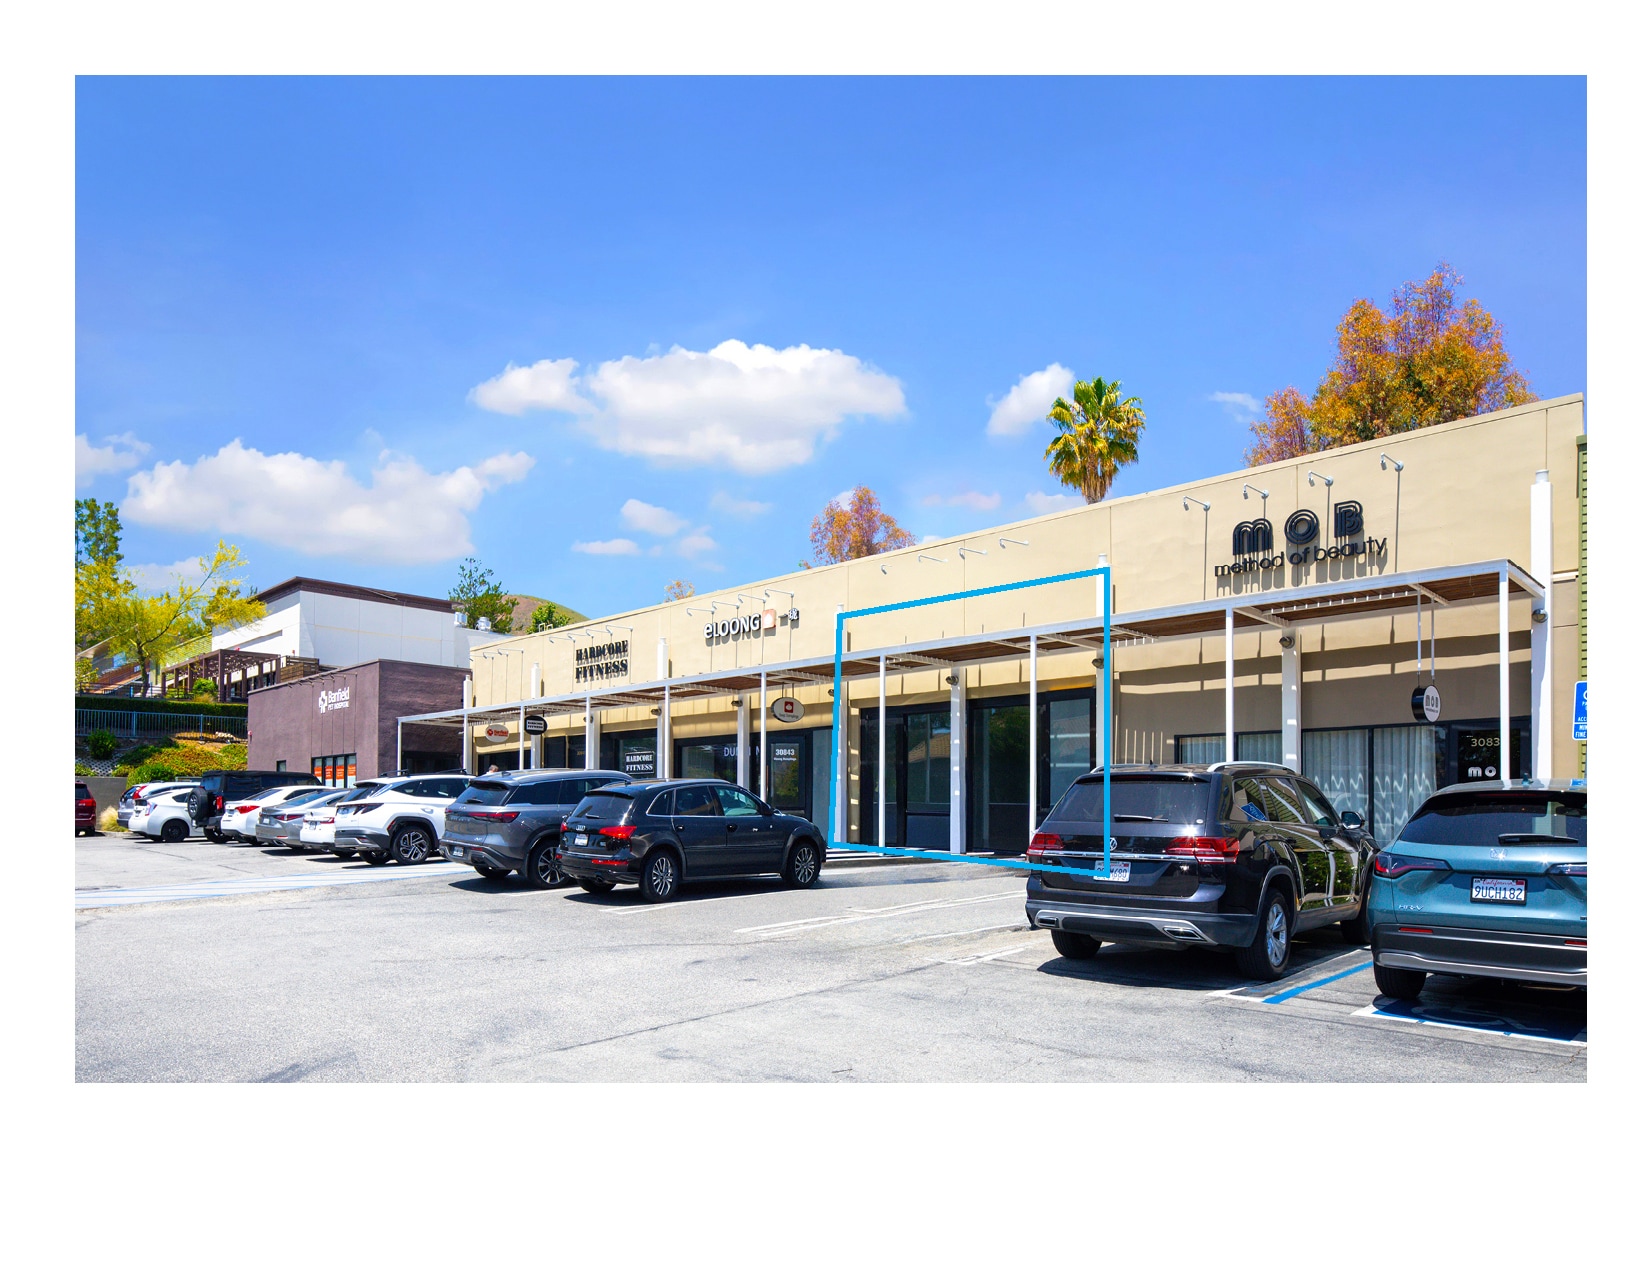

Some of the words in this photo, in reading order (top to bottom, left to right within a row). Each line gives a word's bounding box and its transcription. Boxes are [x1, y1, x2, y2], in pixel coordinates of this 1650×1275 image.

[1215, 552, 1284, 576] method
[1290, 546, 1311, 565] of
[1313, 536, 1387, 561] beauty
[575, 640, 628, 661] HARDCORE
[575, 659, 628, 679] FITNESS
[328, 687, 350, 703] Banfield
[1471, 737, 1500, 747] 3083
[625, 754, 653, 762] HARDCORE
[775, 748, 795, 756] 30843
[625, 763, 654, 772] FITNESS
[1474, 885, 1523, 900] 9UCH182
